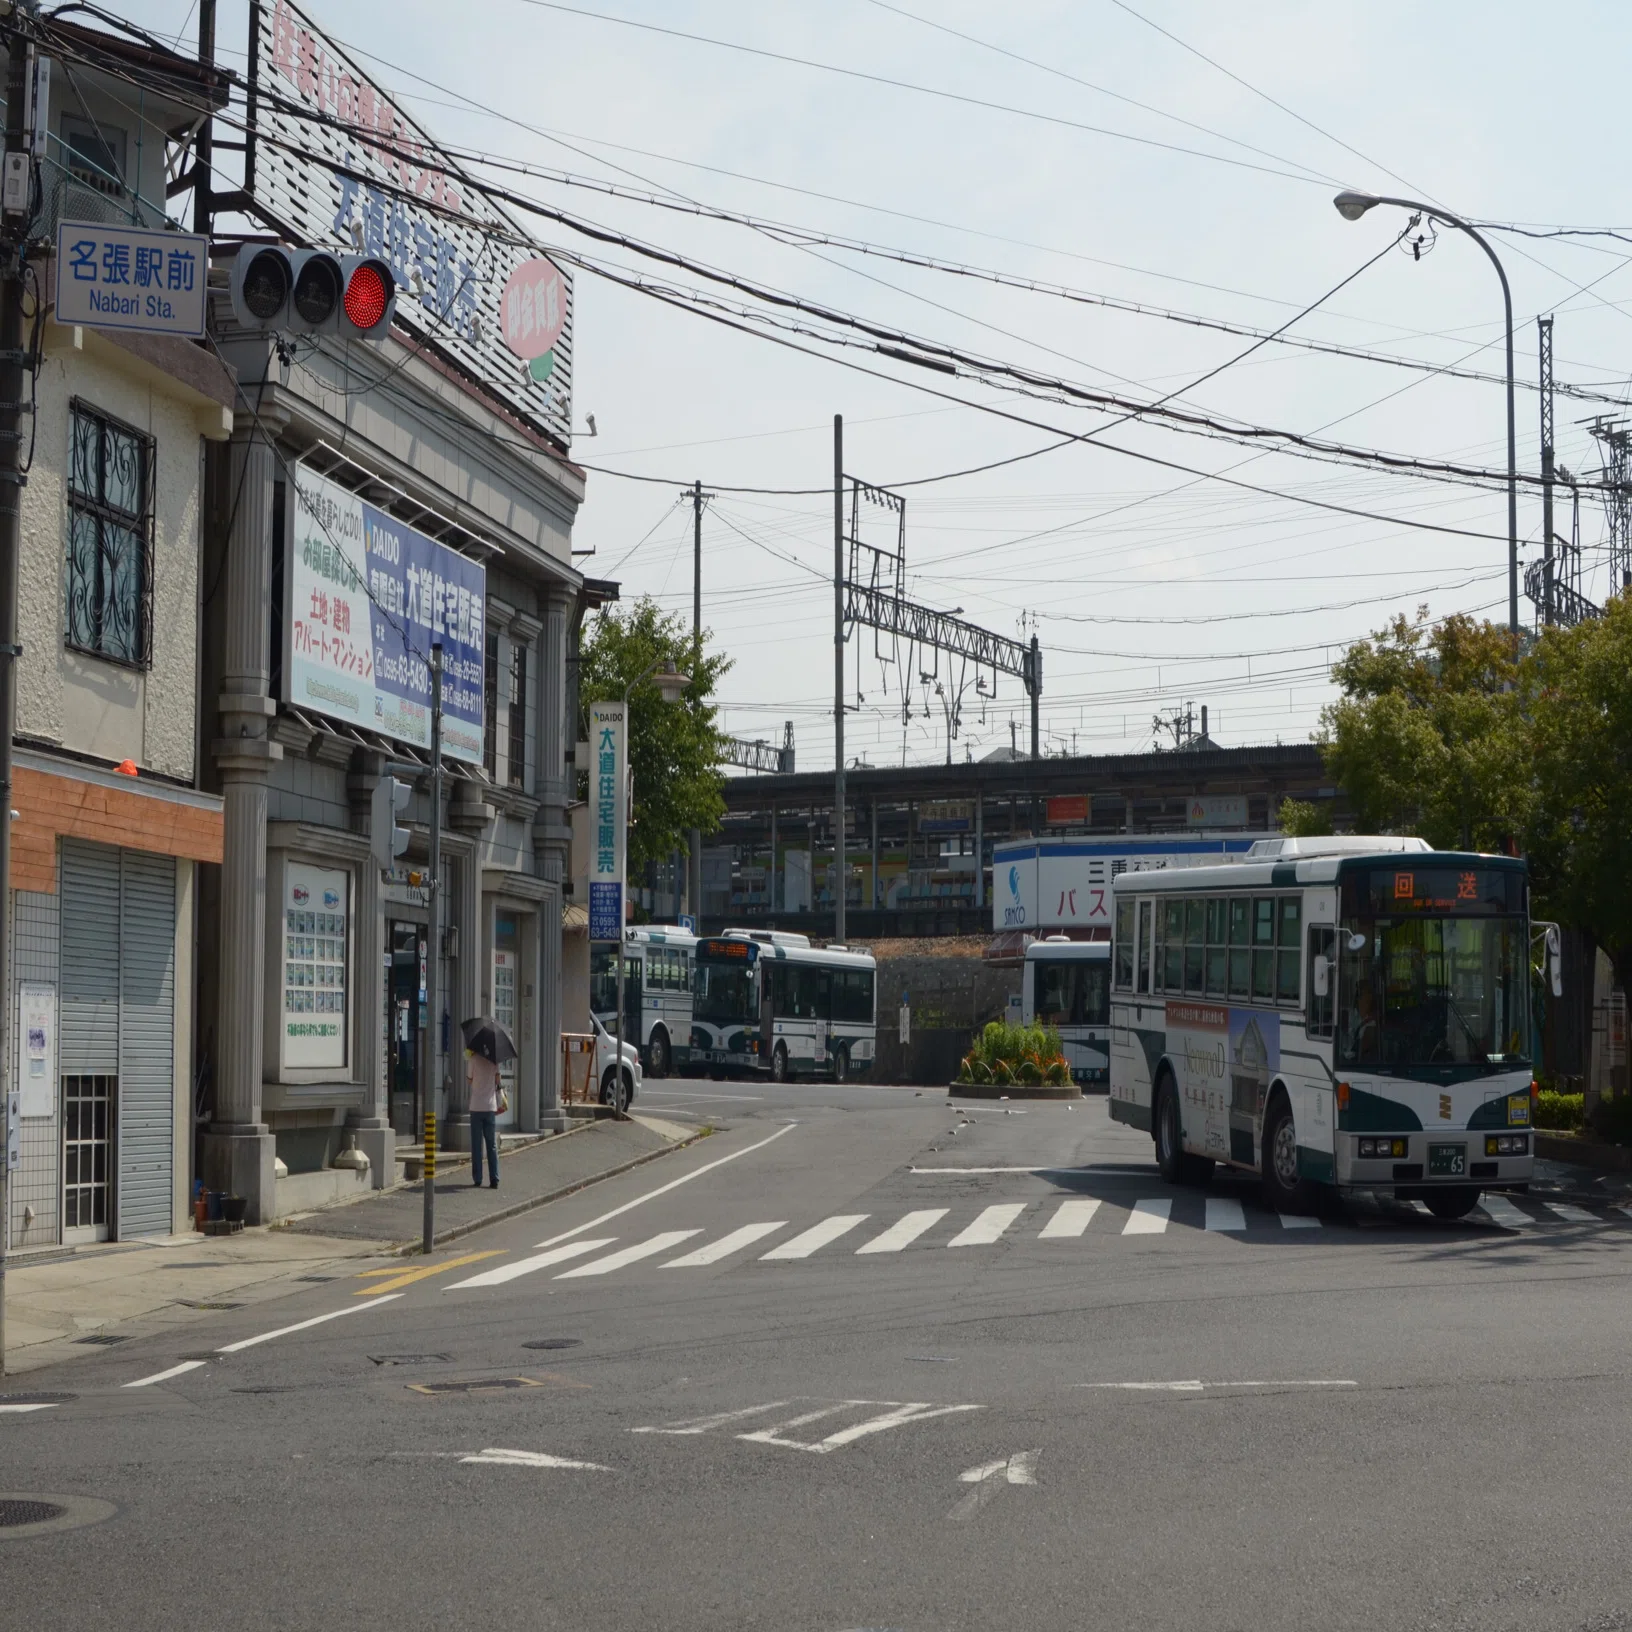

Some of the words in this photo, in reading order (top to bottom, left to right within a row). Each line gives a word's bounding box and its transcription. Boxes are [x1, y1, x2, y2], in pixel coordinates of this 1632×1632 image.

[272, 0, 460, 211] 住まいの情報センター
[69, 240, 195, 291] 名張駅前
[333, 151, 477, 341] 大道住宅販売
[90, 289, 139, 316] Nabari
[145, 295, 176, 319] Sta.
[303, 535, 358, 593] お部屋探しは
[372, 525, 400, 565] DAIDO
[310, 587, 350, 635] 土地・建物
[371, 568, 404, 617] 有限会社
[406, 562, 482, 652] 大道住宅販売
[294, 620, 373, 678] アパート・マンション
[383, 654, 428, 694] 0595-63-5430
[599, 713, 623, 722] DAIDO
[597, 727, 616, 873] 大道住宅販売
[599, 917, 616, 926] 0595
[1057, 888, 1108, 917] バス
[591, 927, 620, 938] 63-5430
